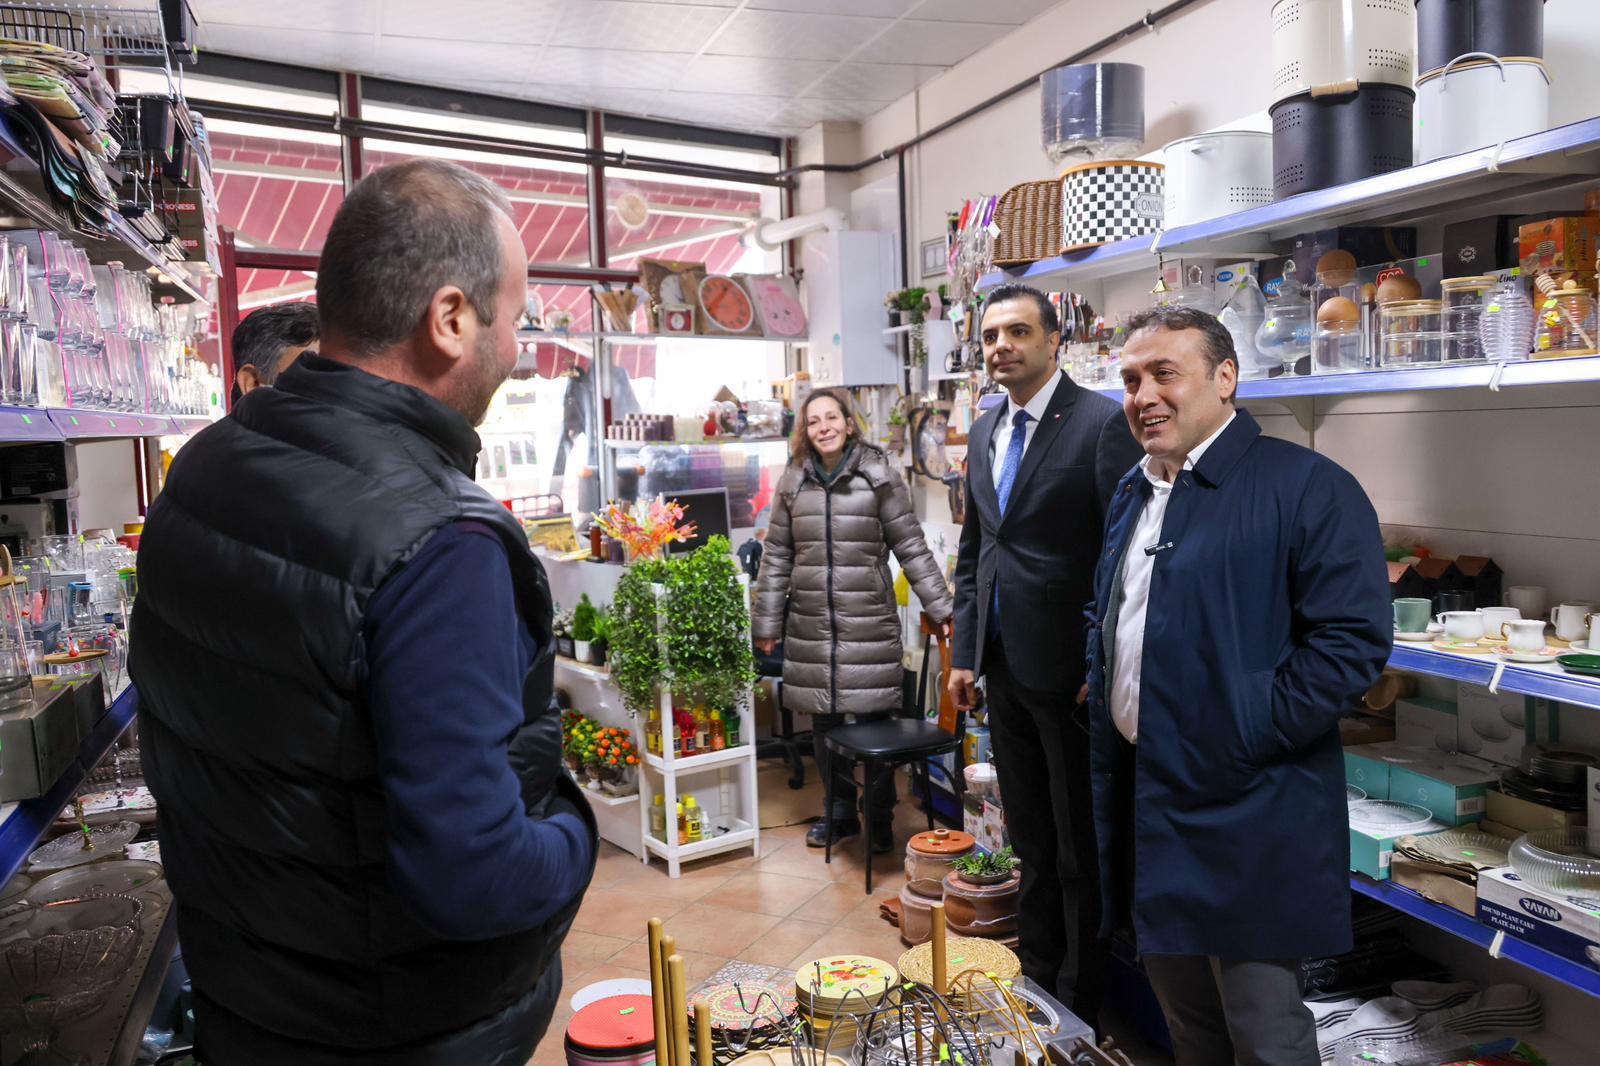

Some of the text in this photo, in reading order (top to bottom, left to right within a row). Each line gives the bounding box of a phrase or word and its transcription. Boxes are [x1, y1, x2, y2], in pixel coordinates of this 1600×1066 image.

[1481, 904, 1536, 930] ROUND PLANE CAKE
[1522, 898, 1559, 921] RAYAN
[1491, 916, 1509, 928] PLATE
